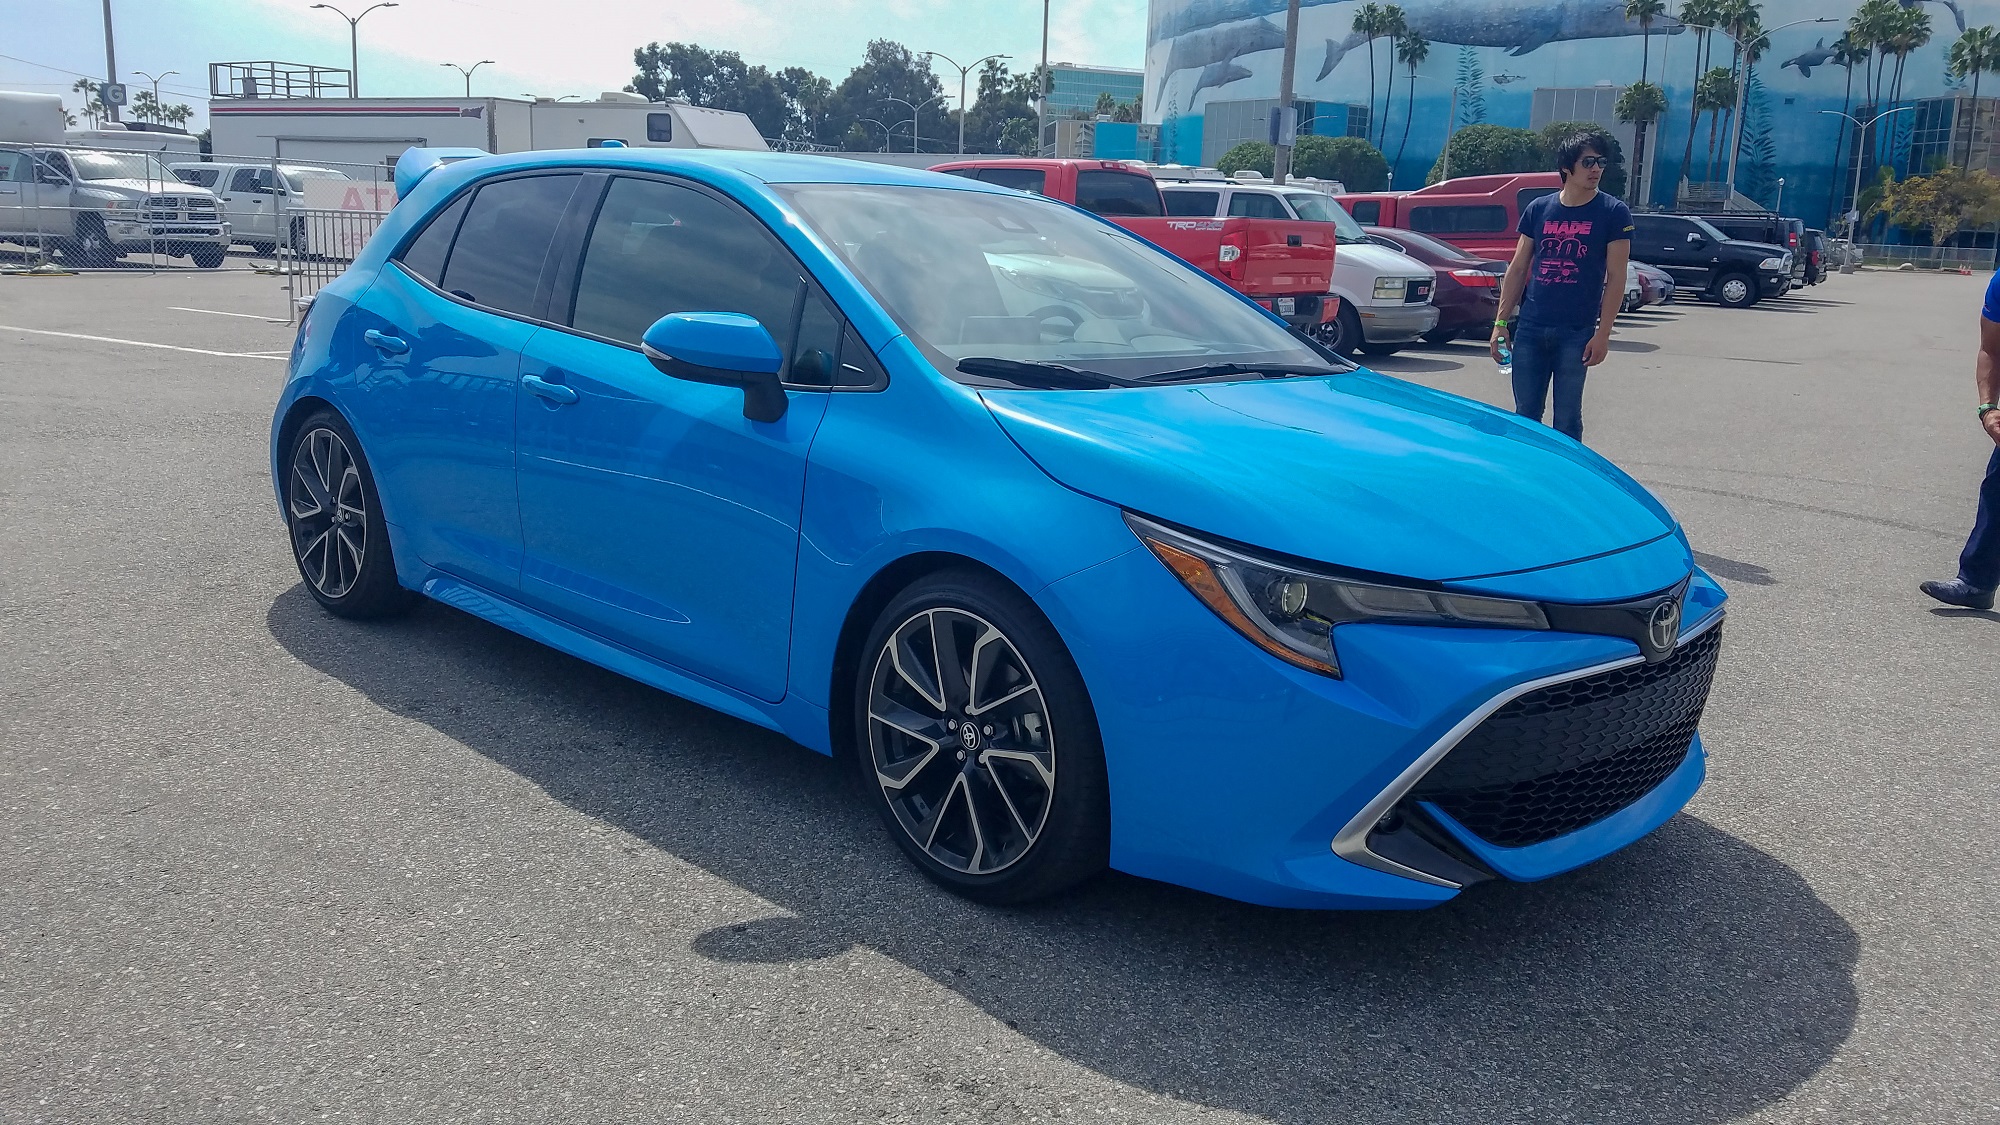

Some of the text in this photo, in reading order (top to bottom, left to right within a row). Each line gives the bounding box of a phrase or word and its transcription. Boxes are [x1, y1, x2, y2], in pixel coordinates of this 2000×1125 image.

[107, 85, 123, 103] G
[341, 187, 398, 219] AT
[1167, 221, 1197, 231] TRD
[1543, 221, 1593, 234] MADE
